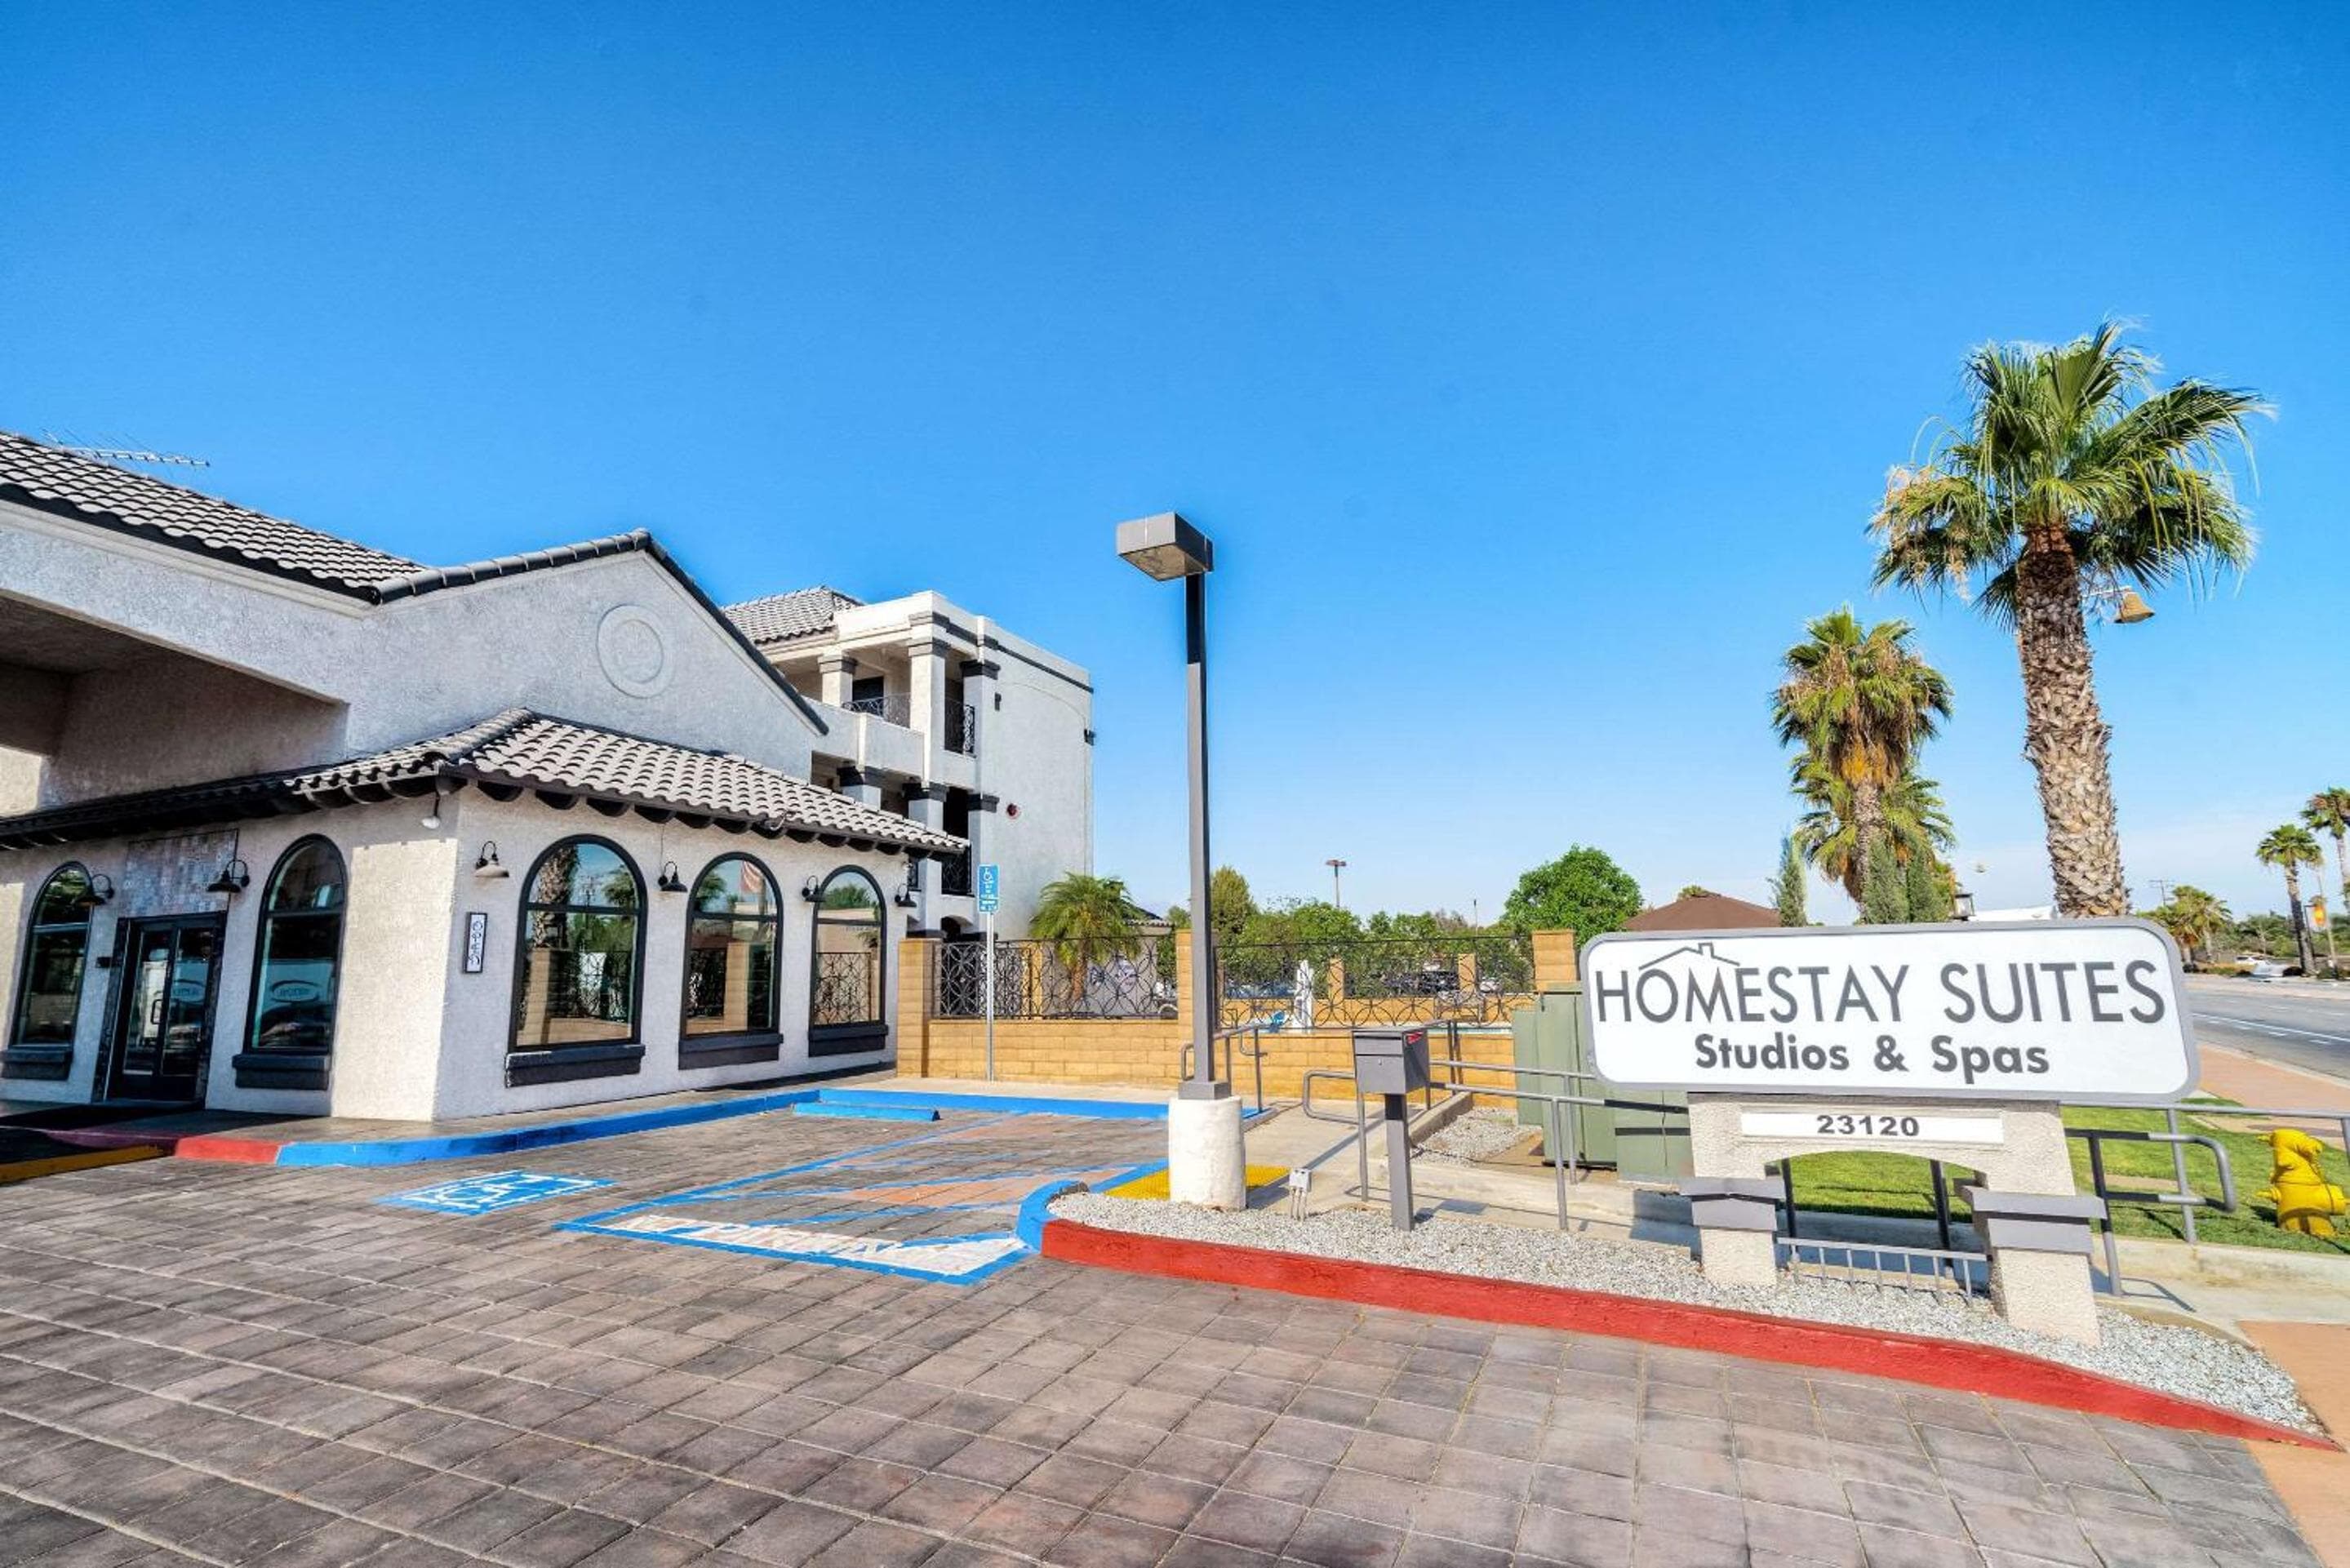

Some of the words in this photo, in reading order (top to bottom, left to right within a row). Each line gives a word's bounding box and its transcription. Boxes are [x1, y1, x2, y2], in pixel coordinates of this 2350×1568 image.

[1596, 965, 1909, 1024] HOMESTAY
[1940, 960, 2165, 1024] SUITES
[1695, 1032, 1850, 1071] Studios
[1873, 1035, 1908, 1072] &
[1931, 1035, 2050, 1085] Spas
[1816, 1114, 1919, 1137] 23120
